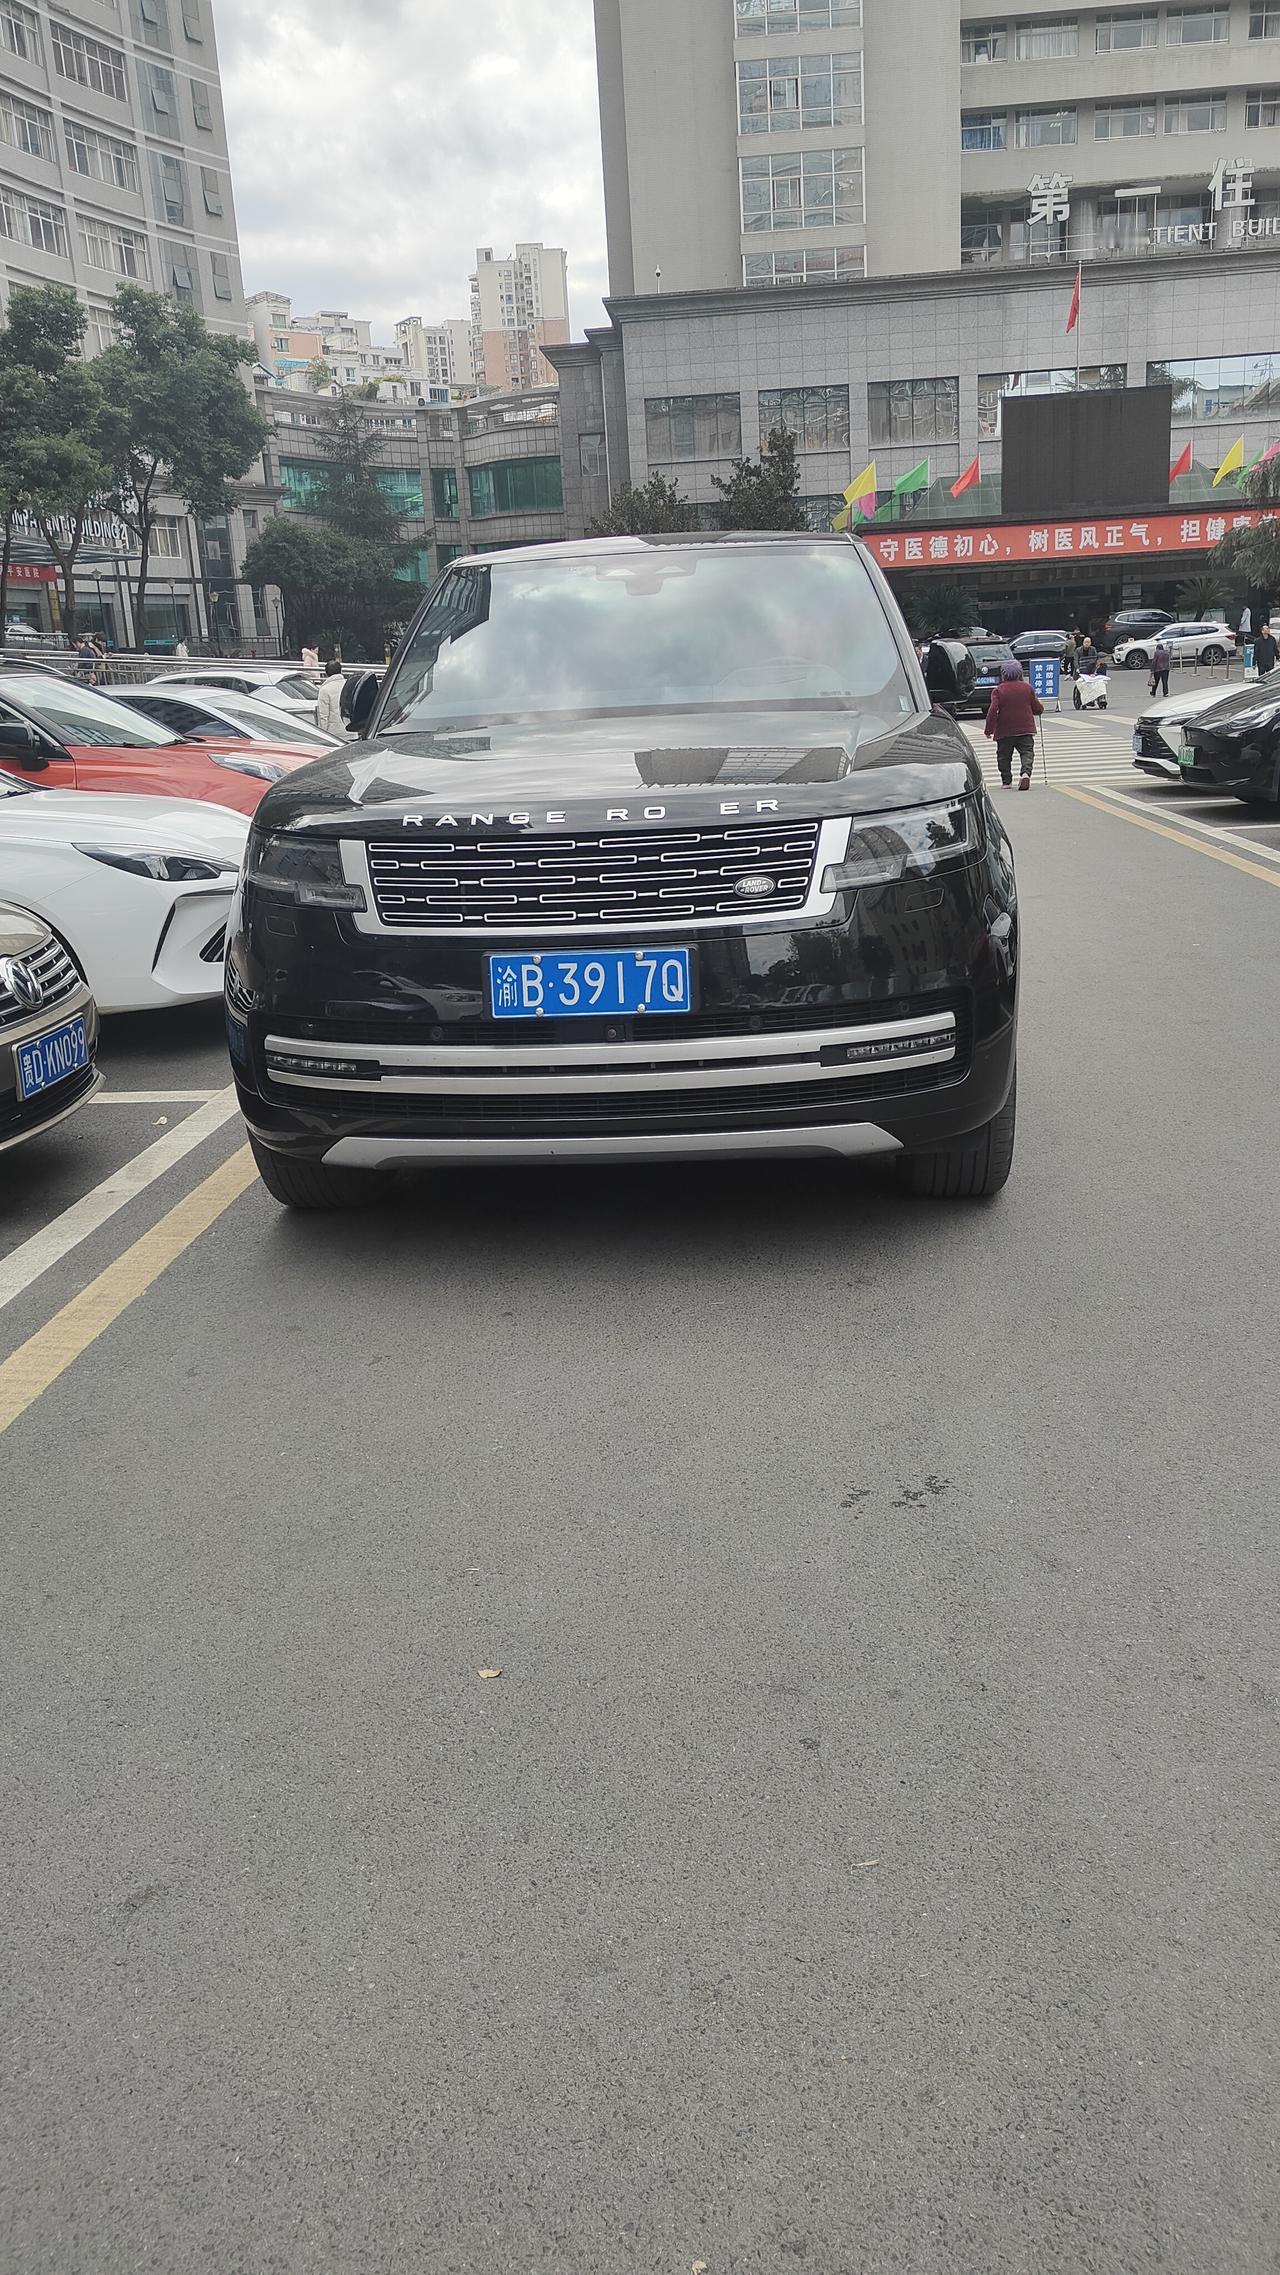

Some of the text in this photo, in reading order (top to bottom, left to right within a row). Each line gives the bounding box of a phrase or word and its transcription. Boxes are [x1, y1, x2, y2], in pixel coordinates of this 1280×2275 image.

[0, 563, 40, 578] 平安医院
[401, 799, 779, 827] RANGE ROER
